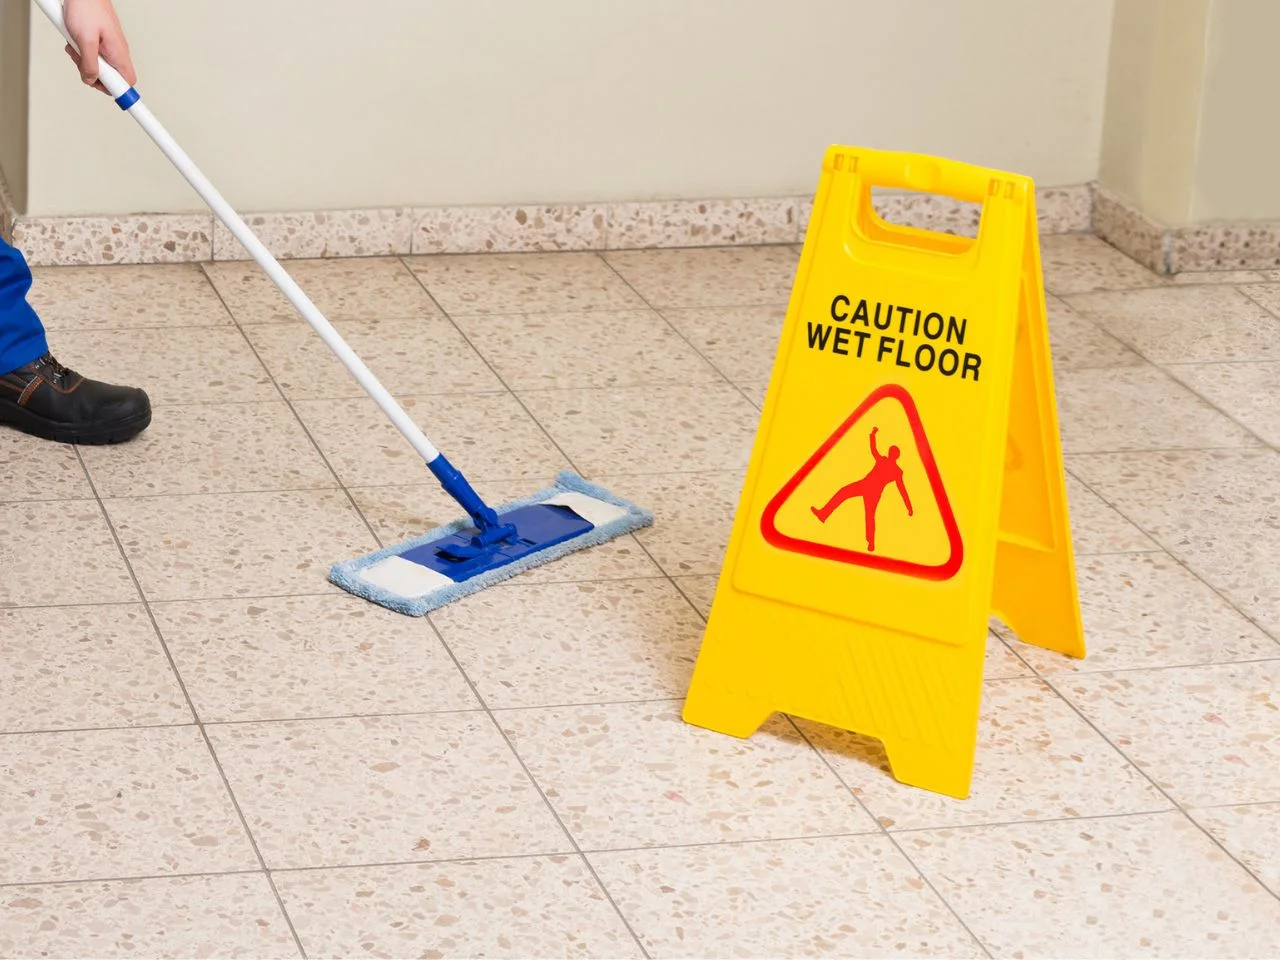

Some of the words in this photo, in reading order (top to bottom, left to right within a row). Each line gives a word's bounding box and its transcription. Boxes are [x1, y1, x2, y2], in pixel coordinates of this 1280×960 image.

[830, 294, 967, 345] CAUTION
[807, 321, 871, 358] WET
[876, 335, 982, 381] FLOOR
